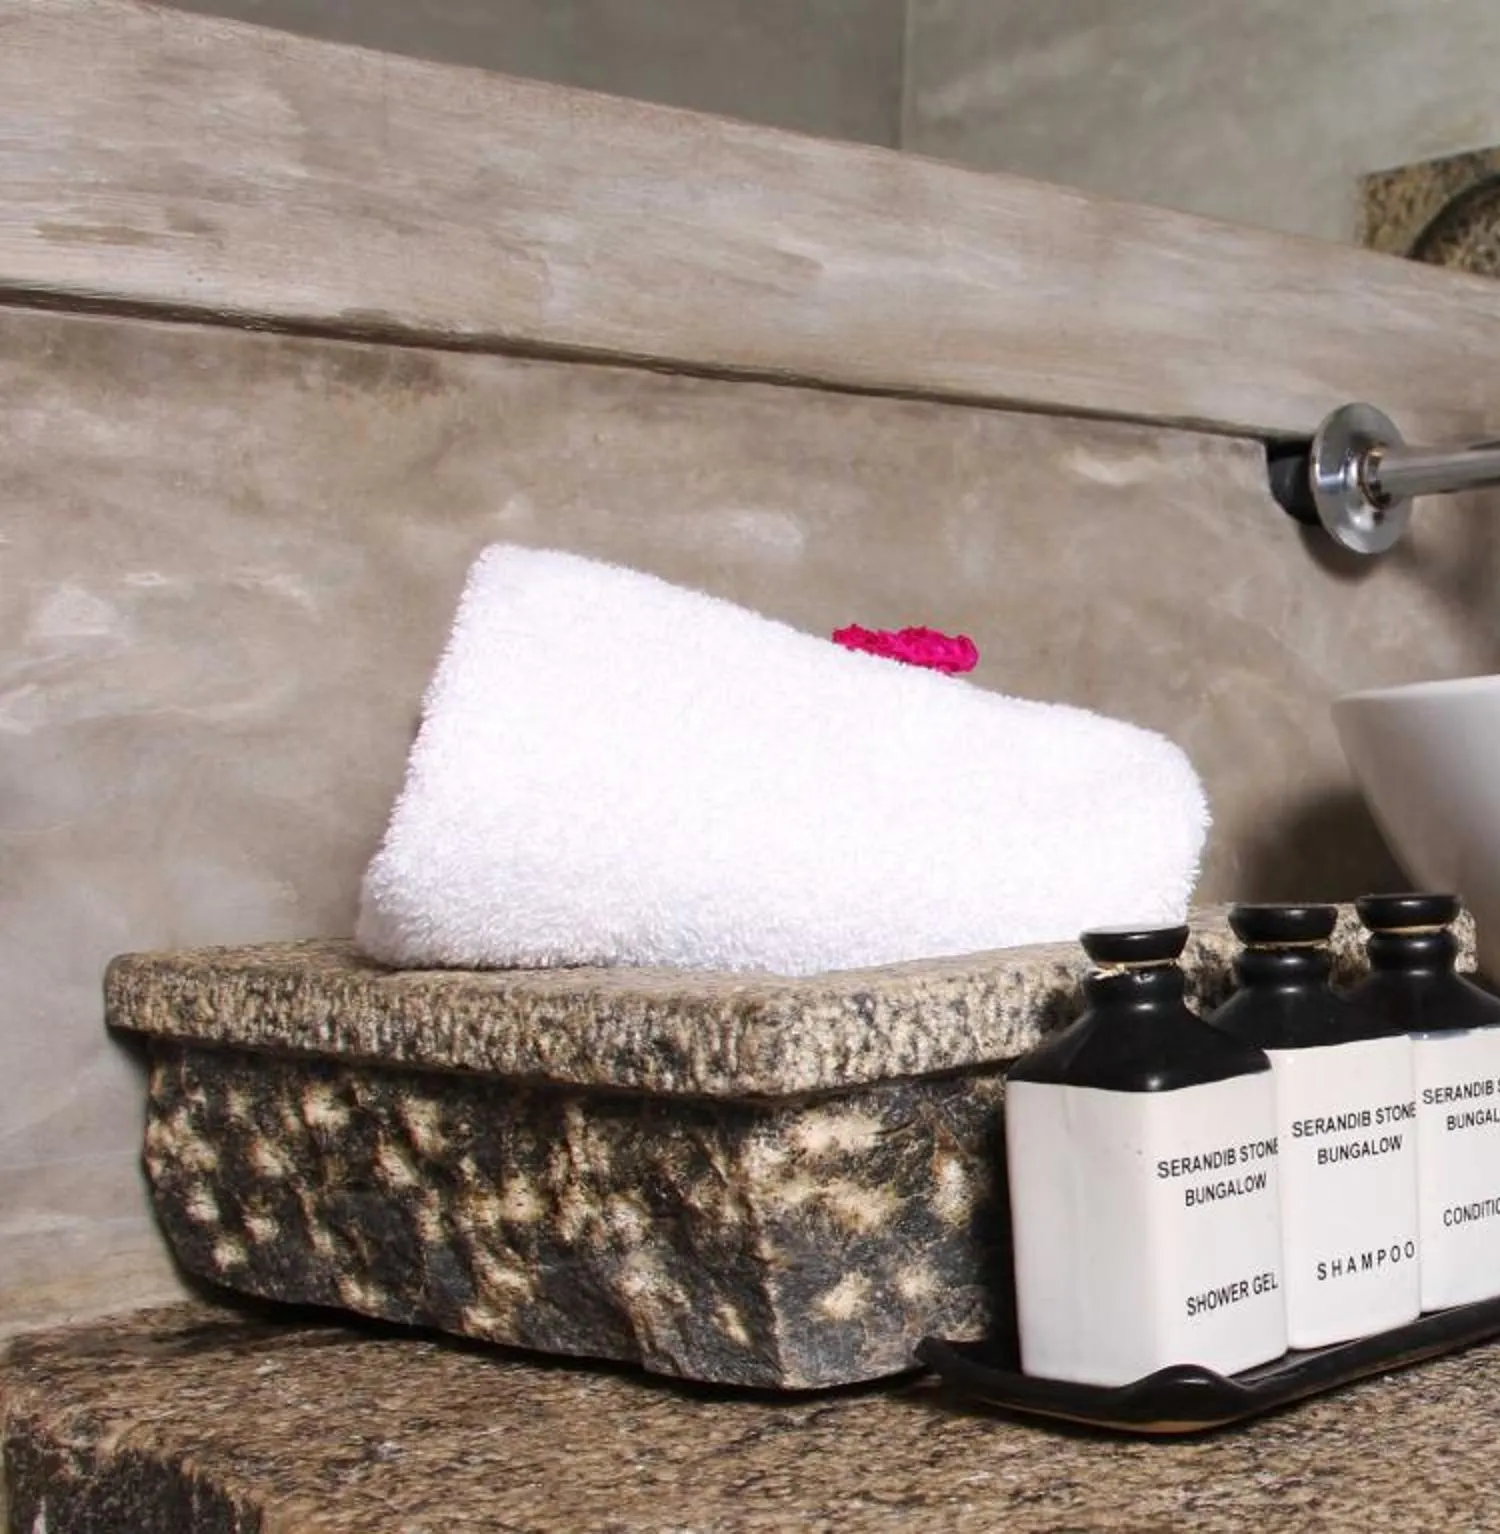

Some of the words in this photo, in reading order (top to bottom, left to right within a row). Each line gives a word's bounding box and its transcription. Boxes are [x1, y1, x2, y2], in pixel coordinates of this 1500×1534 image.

[1422, 1079, 1495, 1105] SERANDIB
[1292, 1110, 1372, 1138] SERANDIB
[1375, 1101, 1416, 1124] STONE
[1157, 1148, 1237, 1179] SERANDIB
[1317, 1134, 1403, 1165] BUNGALOW
[1184, 1171, 1267, 1207] BUNGALOW
[1317, 1241, 1415, 1280] SHAMPOO
[1187, 1280, 1249, 1317] SHOWER
[1252, 1272, 1279, 1295] GEL
